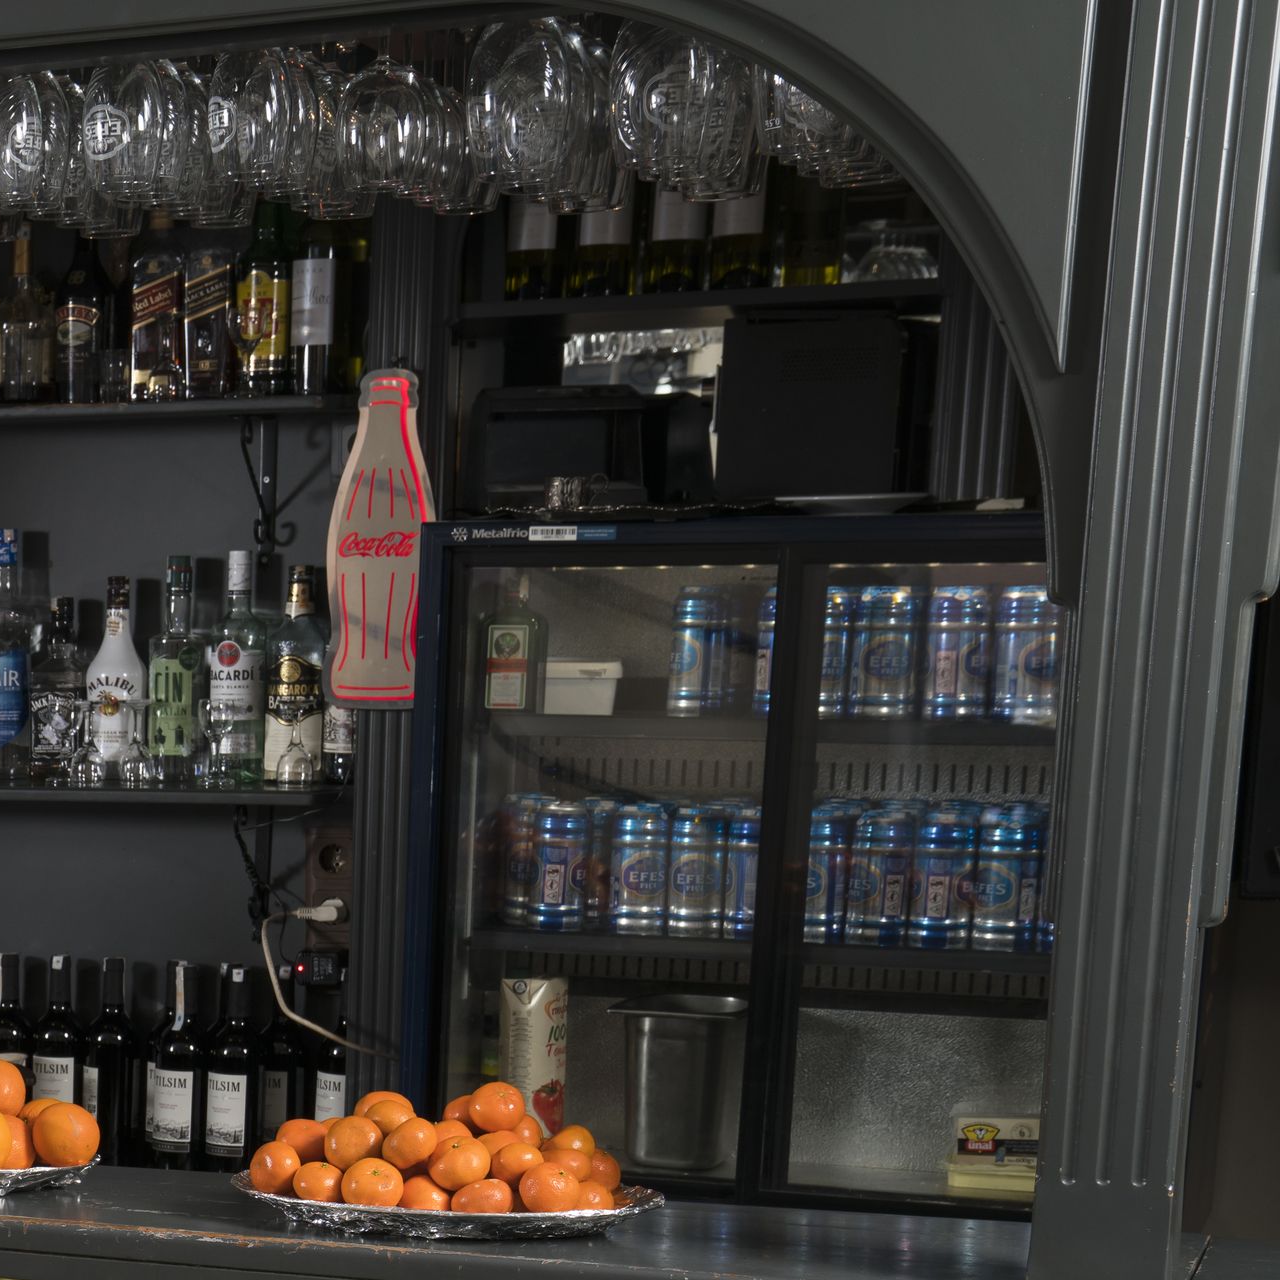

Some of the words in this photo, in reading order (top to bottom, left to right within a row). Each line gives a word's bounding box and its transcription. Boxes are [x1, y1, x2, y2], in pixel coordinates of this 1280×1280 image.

[132, 299, 149, 313] Red
[149, 288, 173, 305] Label
[472, 527, 529, 540] Metalfrio
[338, 531, 418, 558] Coca-Cola
[88, 676, 137, 697] MALIBU
[629, 871, 665, 882] EFES
[676, 873, 714, 885] EFES
[35, 1062, 69, 1075] TILSIM
[156, 1075, 187, 1089] TILSIM
[209, 1079, 240, 1092] TILSIM
[317, 1077, 341, 1092] ILSIM
